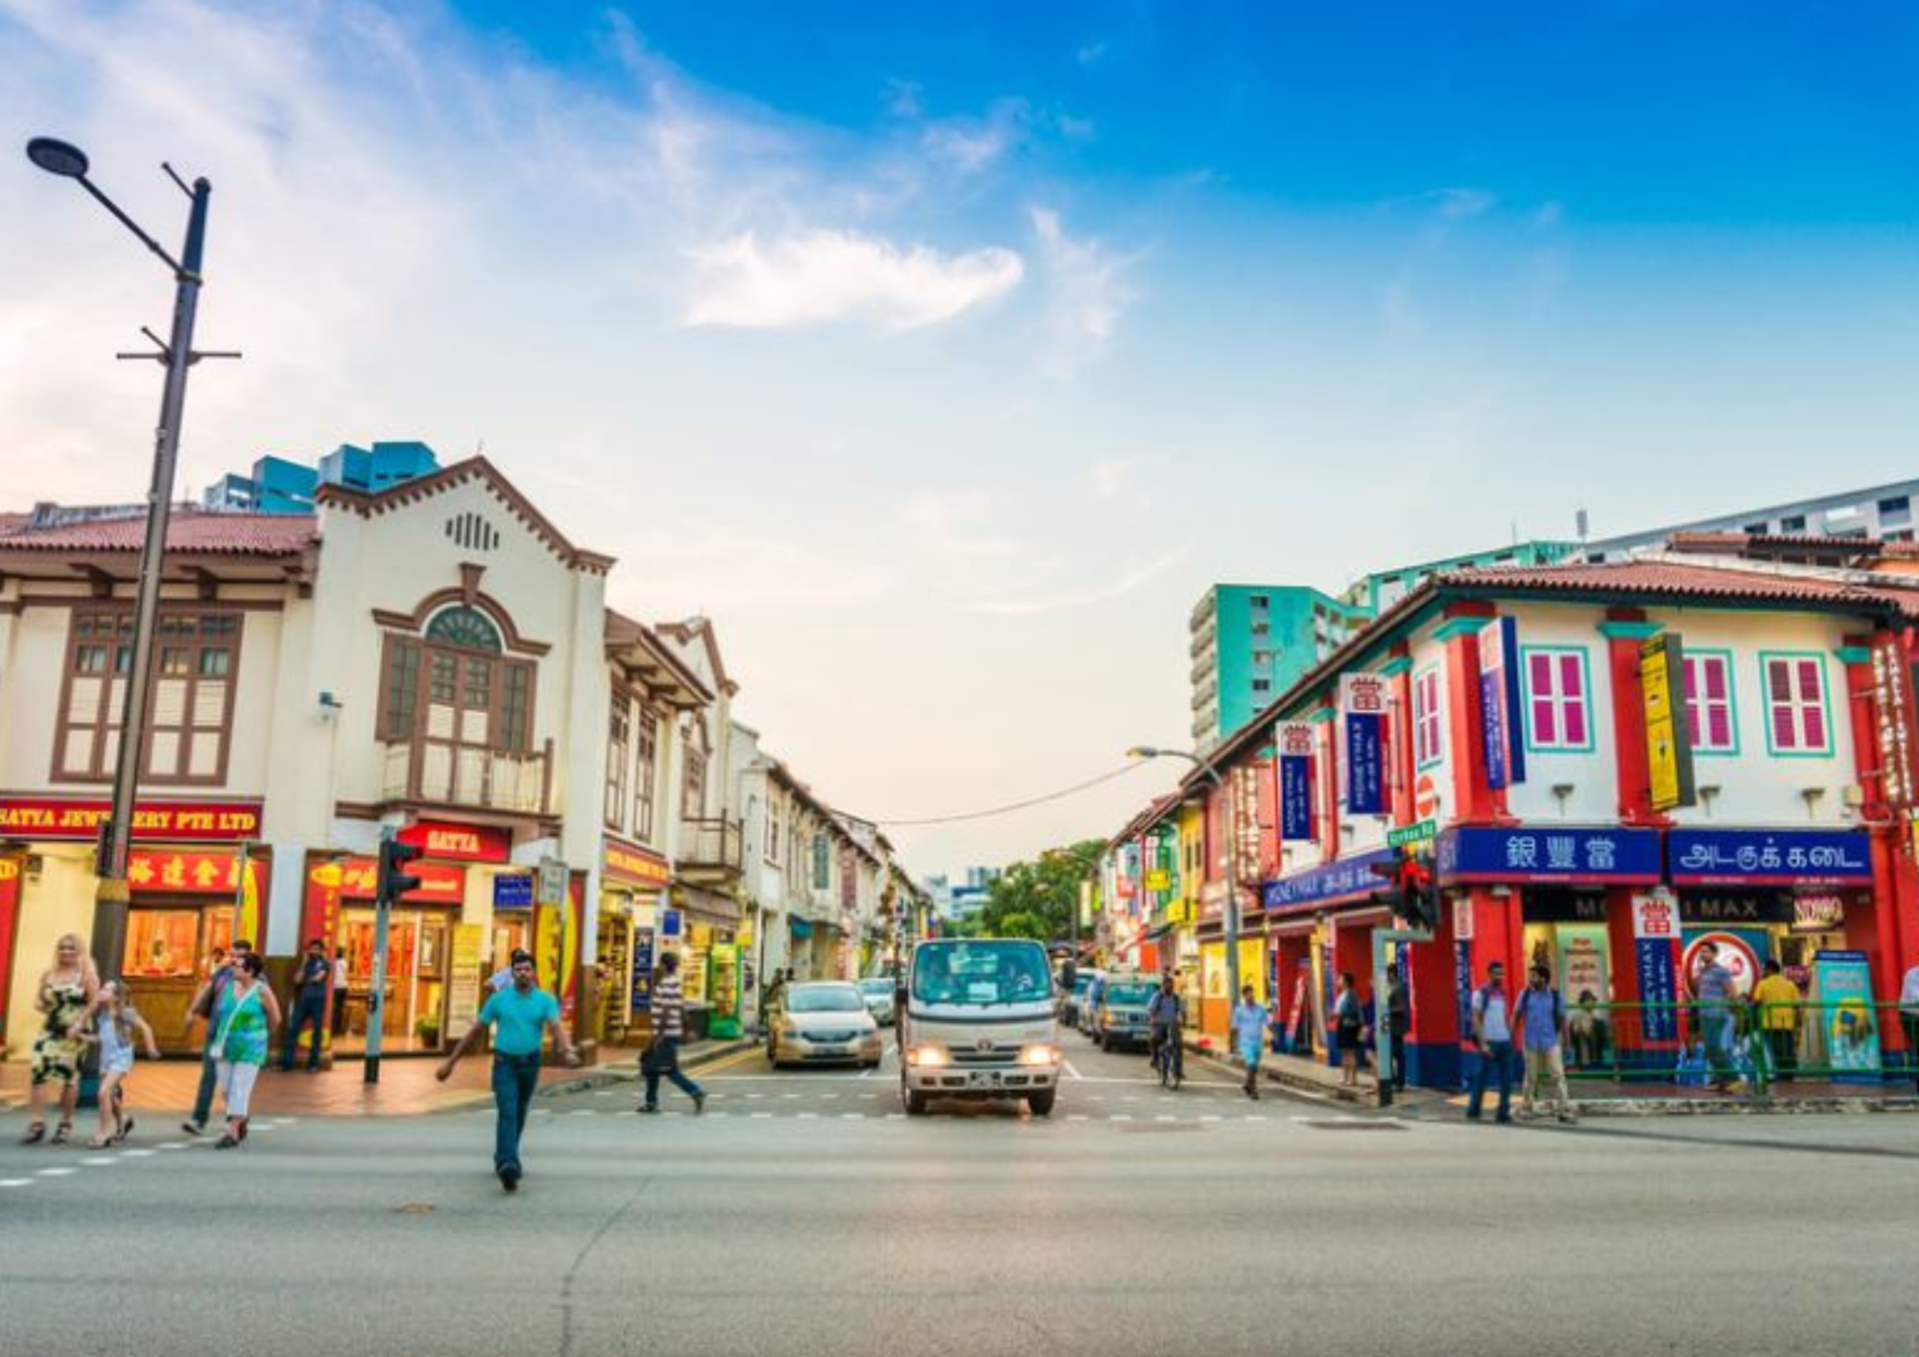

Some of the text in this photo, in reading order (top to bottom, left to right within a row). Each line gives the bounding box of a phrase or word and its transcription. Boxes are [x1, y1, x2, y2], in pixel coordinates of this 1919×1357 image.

[177, 812, 215, 831] PTE
[219, 813, 256, 831] LTD
[428, 830, 479, 852] SATYA
[1506, 835, 1617, 870] 銀豐當
[1786, 845, 1864, 869] கடை
